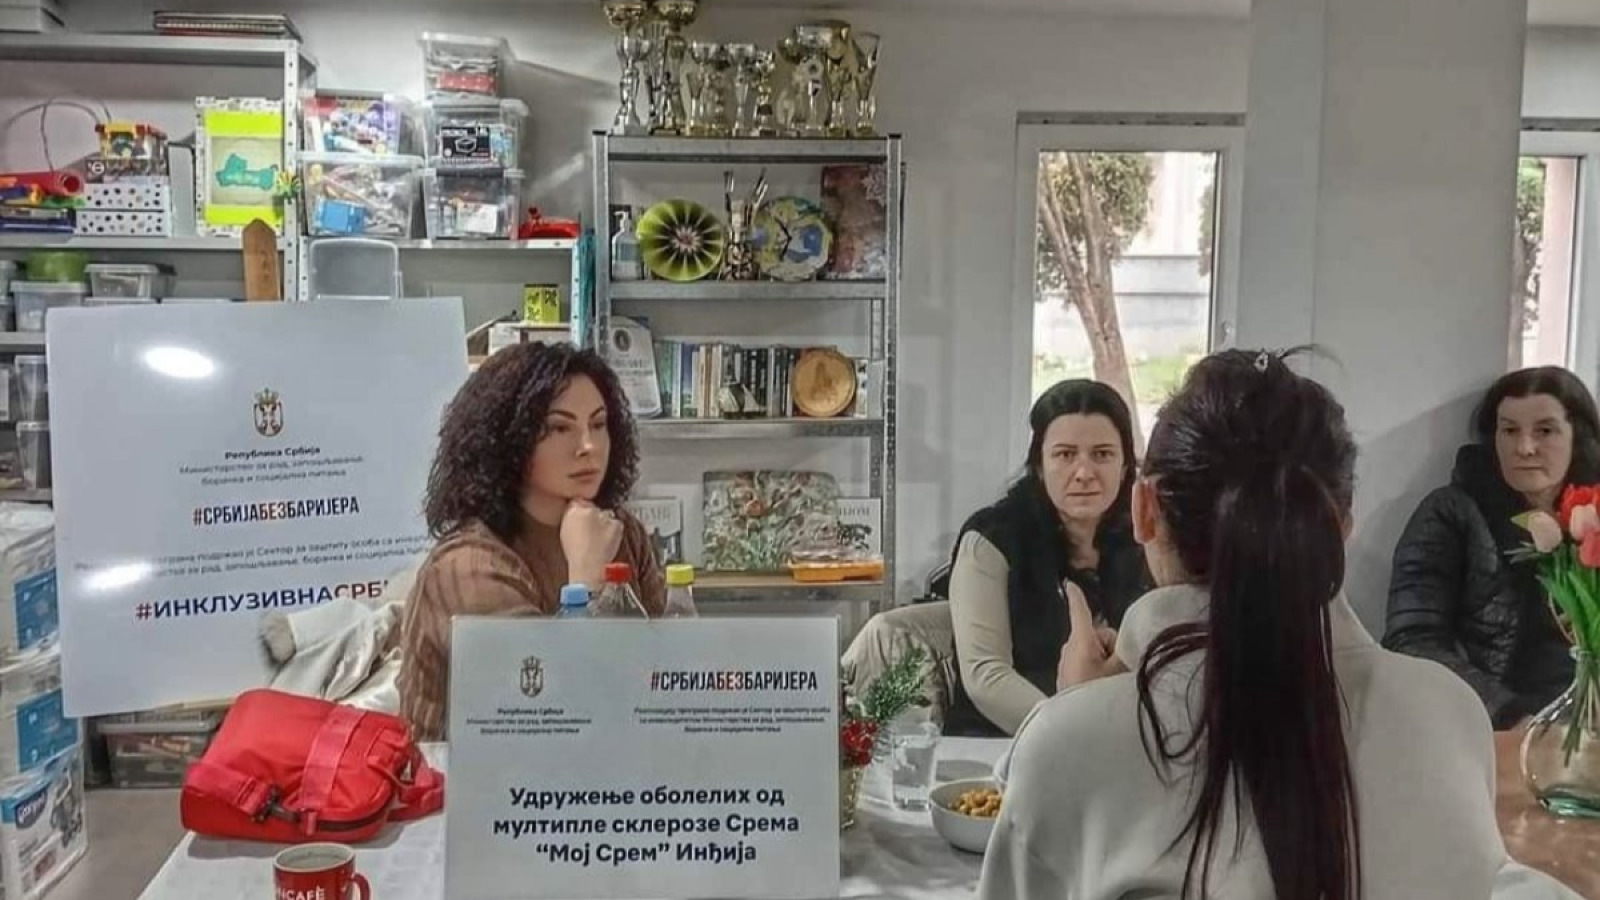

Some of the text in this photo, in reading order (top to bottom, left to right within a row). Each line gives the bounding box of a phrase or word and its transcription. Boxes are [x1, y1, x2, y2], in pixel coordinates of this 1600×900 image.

[284, 447, 320, 457] Србија
[193, 496, 360, 526] #СРБИЈАБЕЗБАРИЈЕРА
[136, 580, 389, 620] #ИНКЛУЗИВНАСРБ
[651, 671, 818, 691] #СРБИЈАБЕЗБАРИЈЕРА
[509, 784, 785, 810] Удружење оболелих од
[493, 812, 799, 839] мултипле склерозе Срема
[676, 841, 756, 865] Инђија
